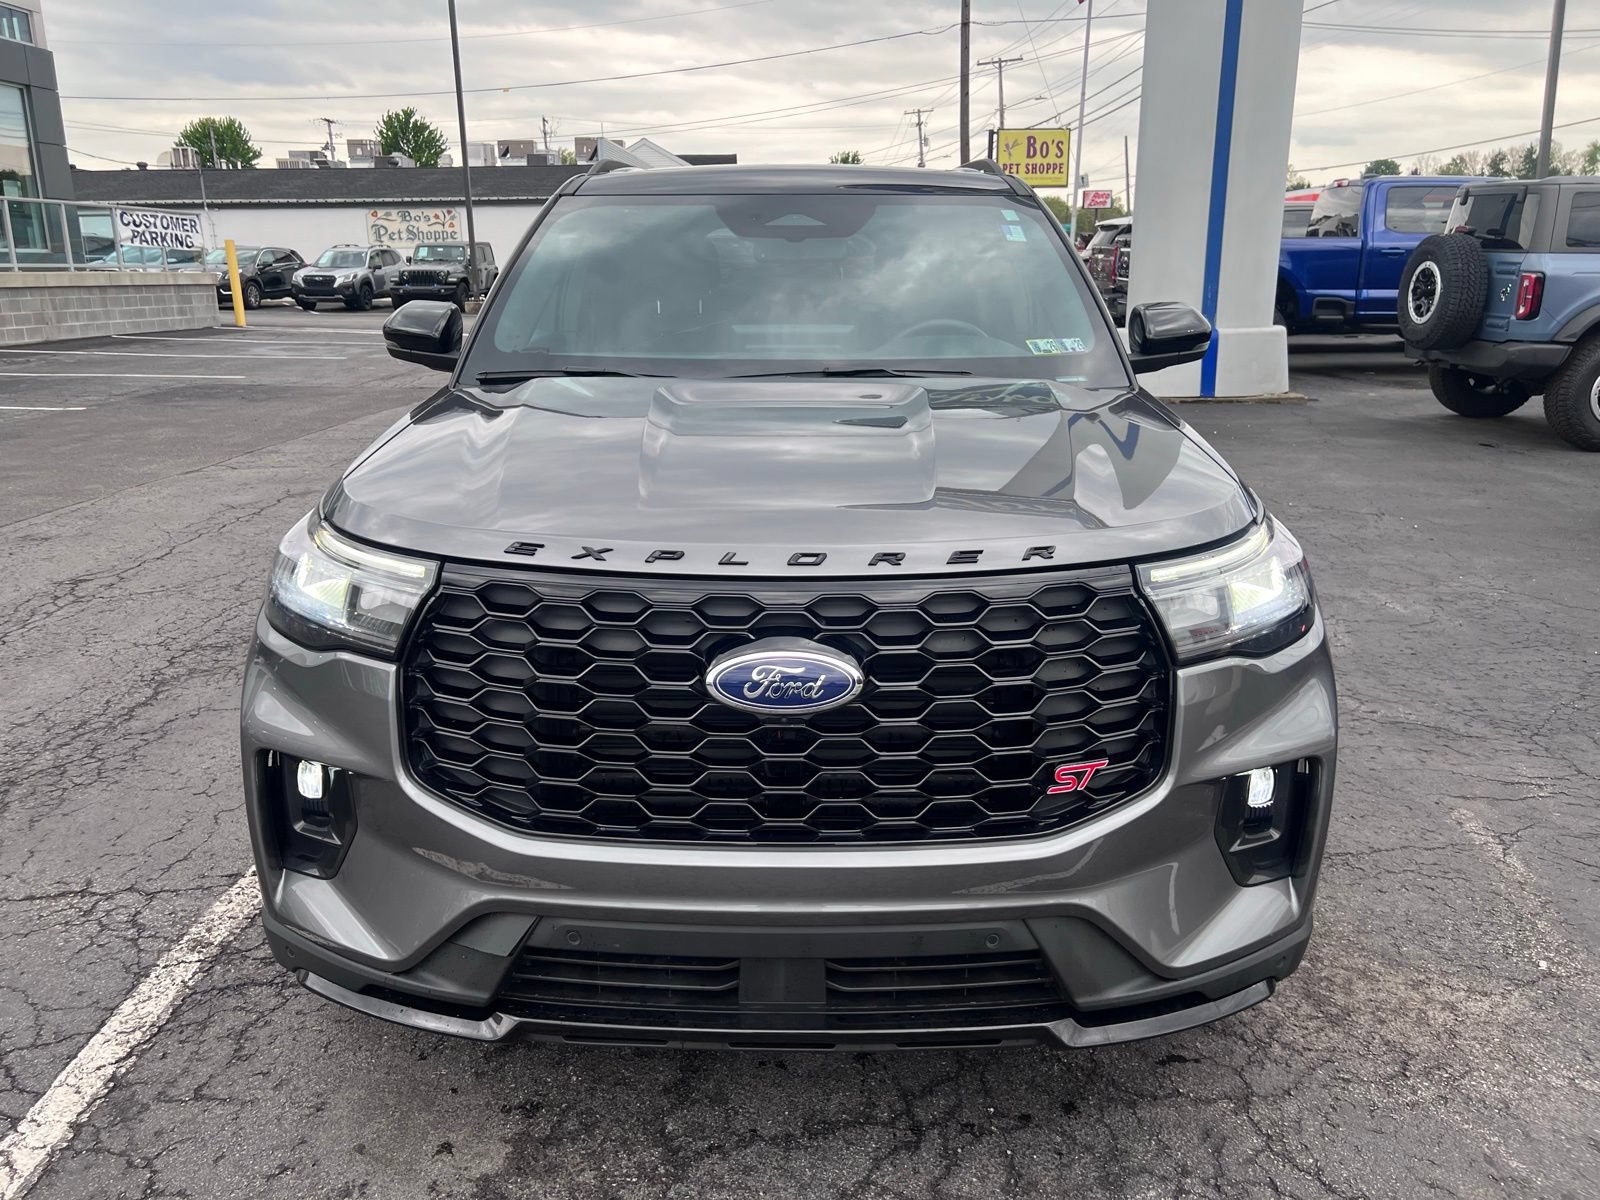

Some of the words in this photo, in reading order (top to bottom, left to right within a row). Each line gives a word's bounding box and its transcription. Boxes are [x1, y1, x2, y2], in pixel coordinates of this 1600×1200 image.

[1026, 136, 1064, 159] Bo's
[1002, 163, 1021, 175] PET
[1025, 162, 1065, 175] SHOPPE
[120, 211, 199, 234] CUSTOMER
[397, 210, 431, 223] Bo's
[131, 229, 194, 249] PARKING
[371, 223, 404, 243] Pet
[405, 224, 458, 243] Shoppe
[504, 541, 1056, 566] EXPLORER
[743, 665, 826, 699] Ford
[1046, 760, 1109, 794] ST
